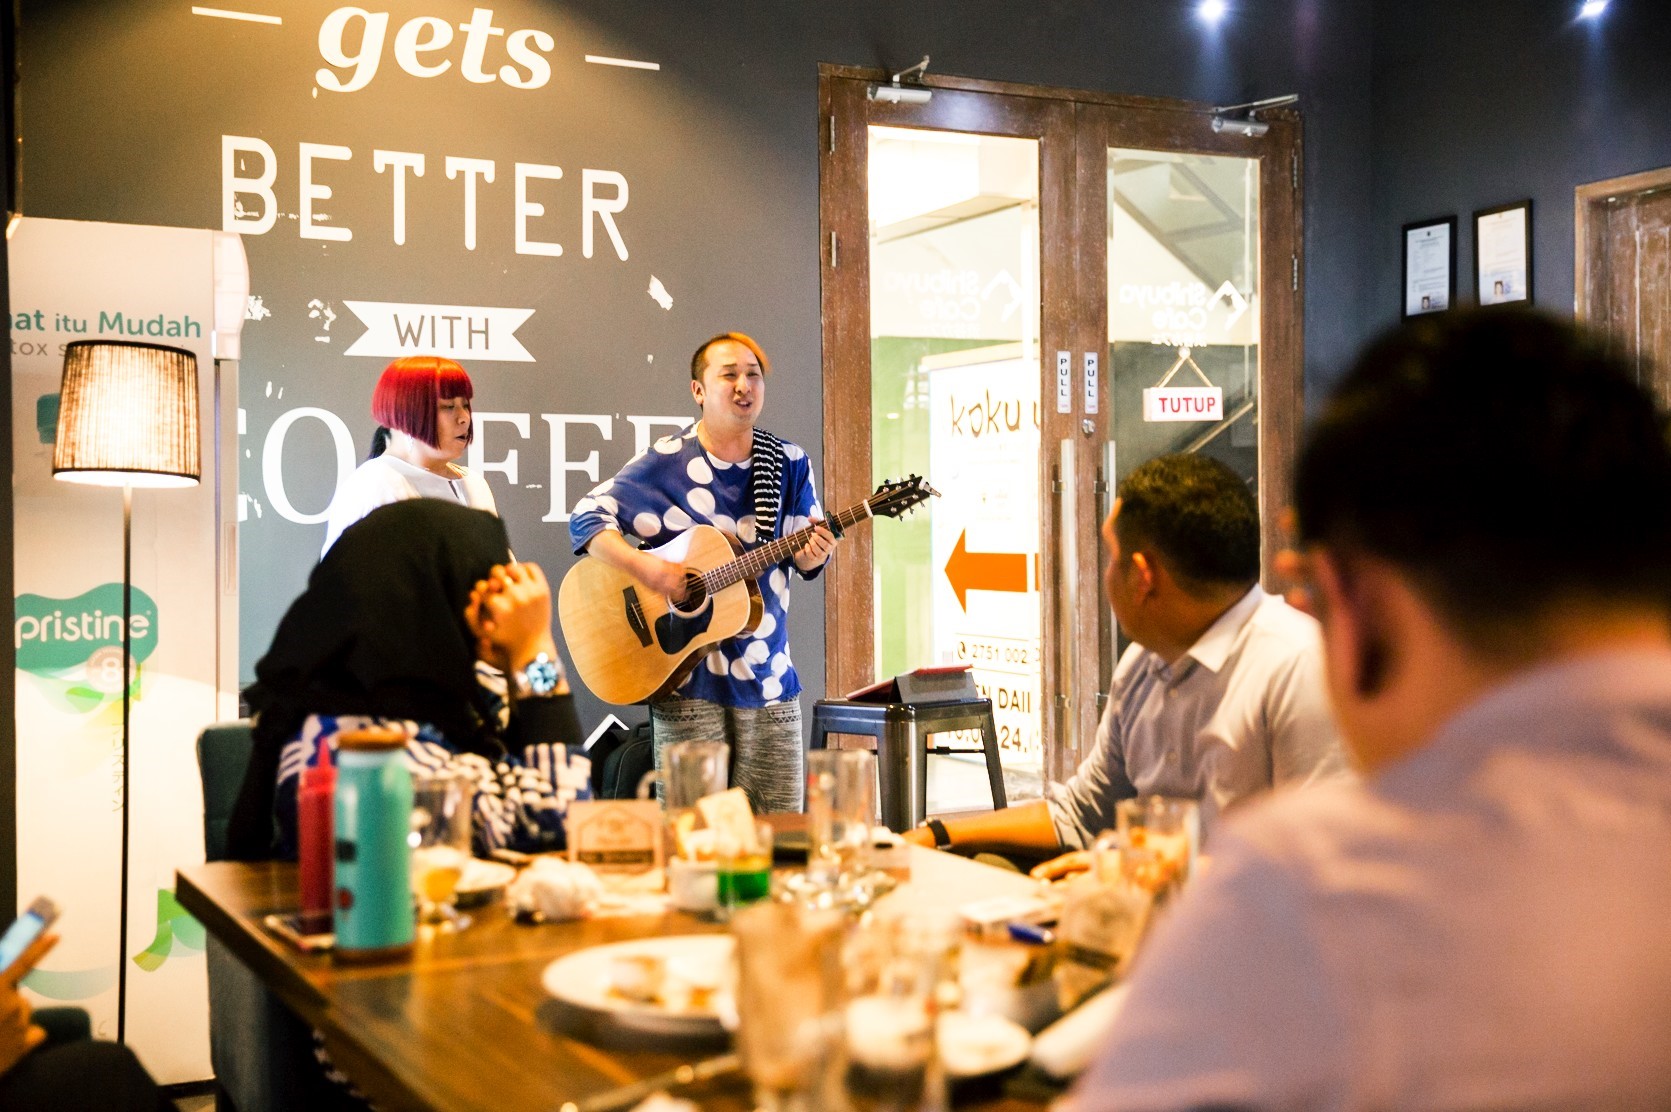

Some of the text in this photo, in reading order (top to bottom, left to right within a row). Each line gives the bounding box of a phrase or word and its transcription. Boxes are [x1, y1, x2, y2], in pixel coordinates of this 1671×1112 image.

[315, 6, 556, 92] gets
[221, 135, 630, 262] BETTER
[9, 309, 201, 338] at itu Mudah
[393, 312, 491, 351] WITH
[1060, 358, 1068, 396] PULL
[1087, 359, 1095, 397] PULL
[1158, 397, 1216, 413] TUTUP
[15, 609, 150, 650] pristine
